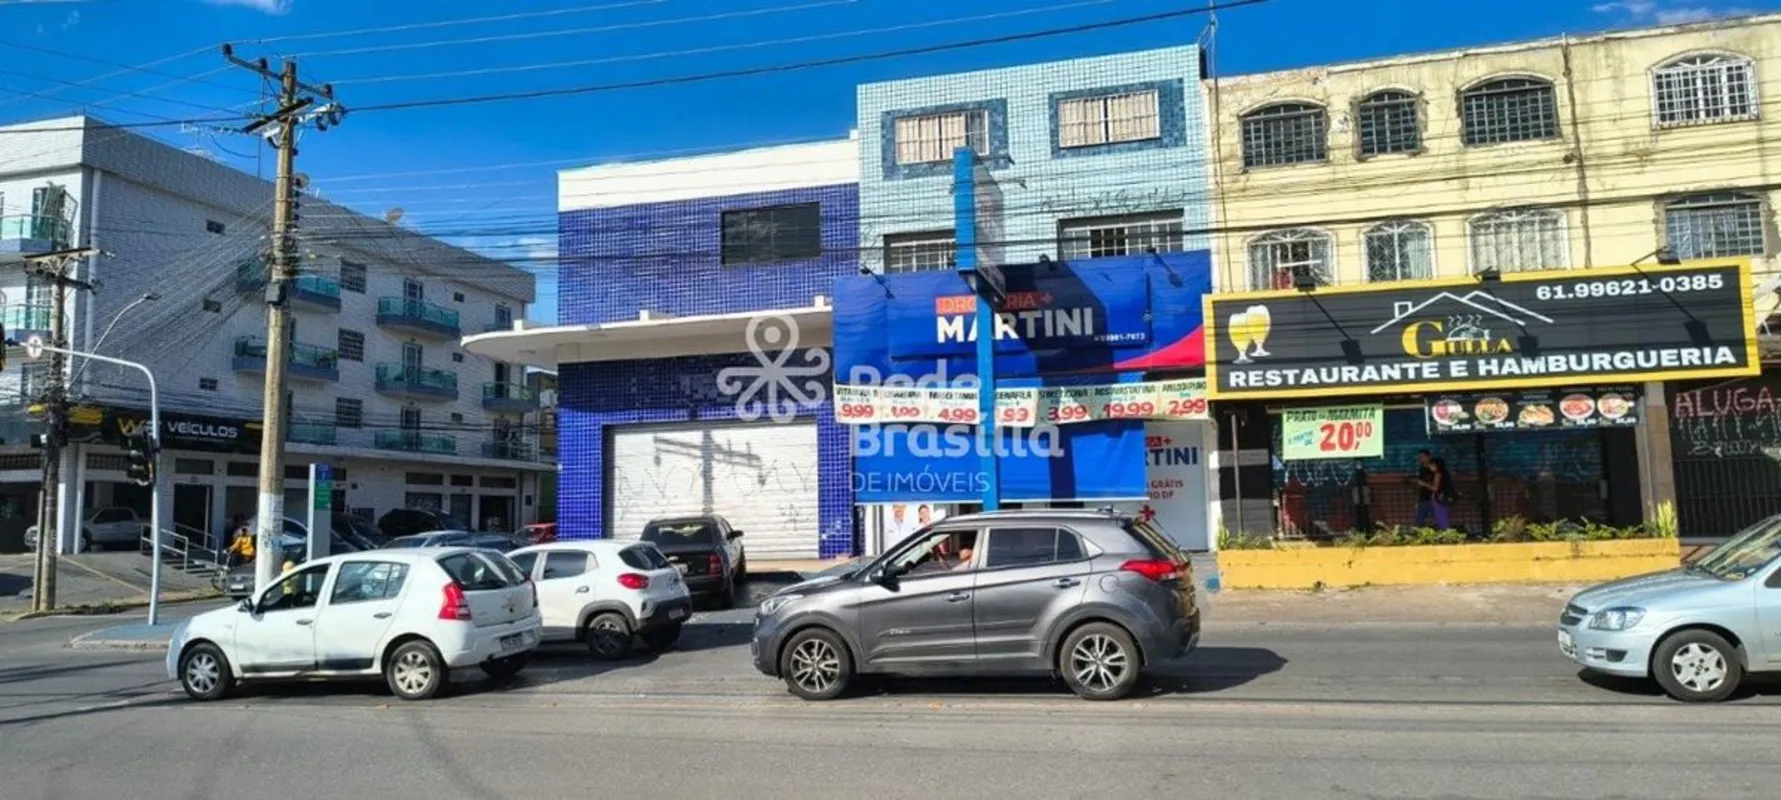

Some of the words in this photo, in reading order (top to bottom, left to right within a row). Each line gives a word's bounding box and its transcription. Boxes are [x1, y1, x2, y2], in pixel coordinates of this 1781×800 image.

[1536, 273, 1724, 300] 61.99621-0385
[1228, 361, 1441, 388] RESTAURANTE
[1449, 359, 1468, 378] E
[1477, 345, 1737, 377] HAMBURGUERIA
[1144, 446, 1198, 467] TINI
